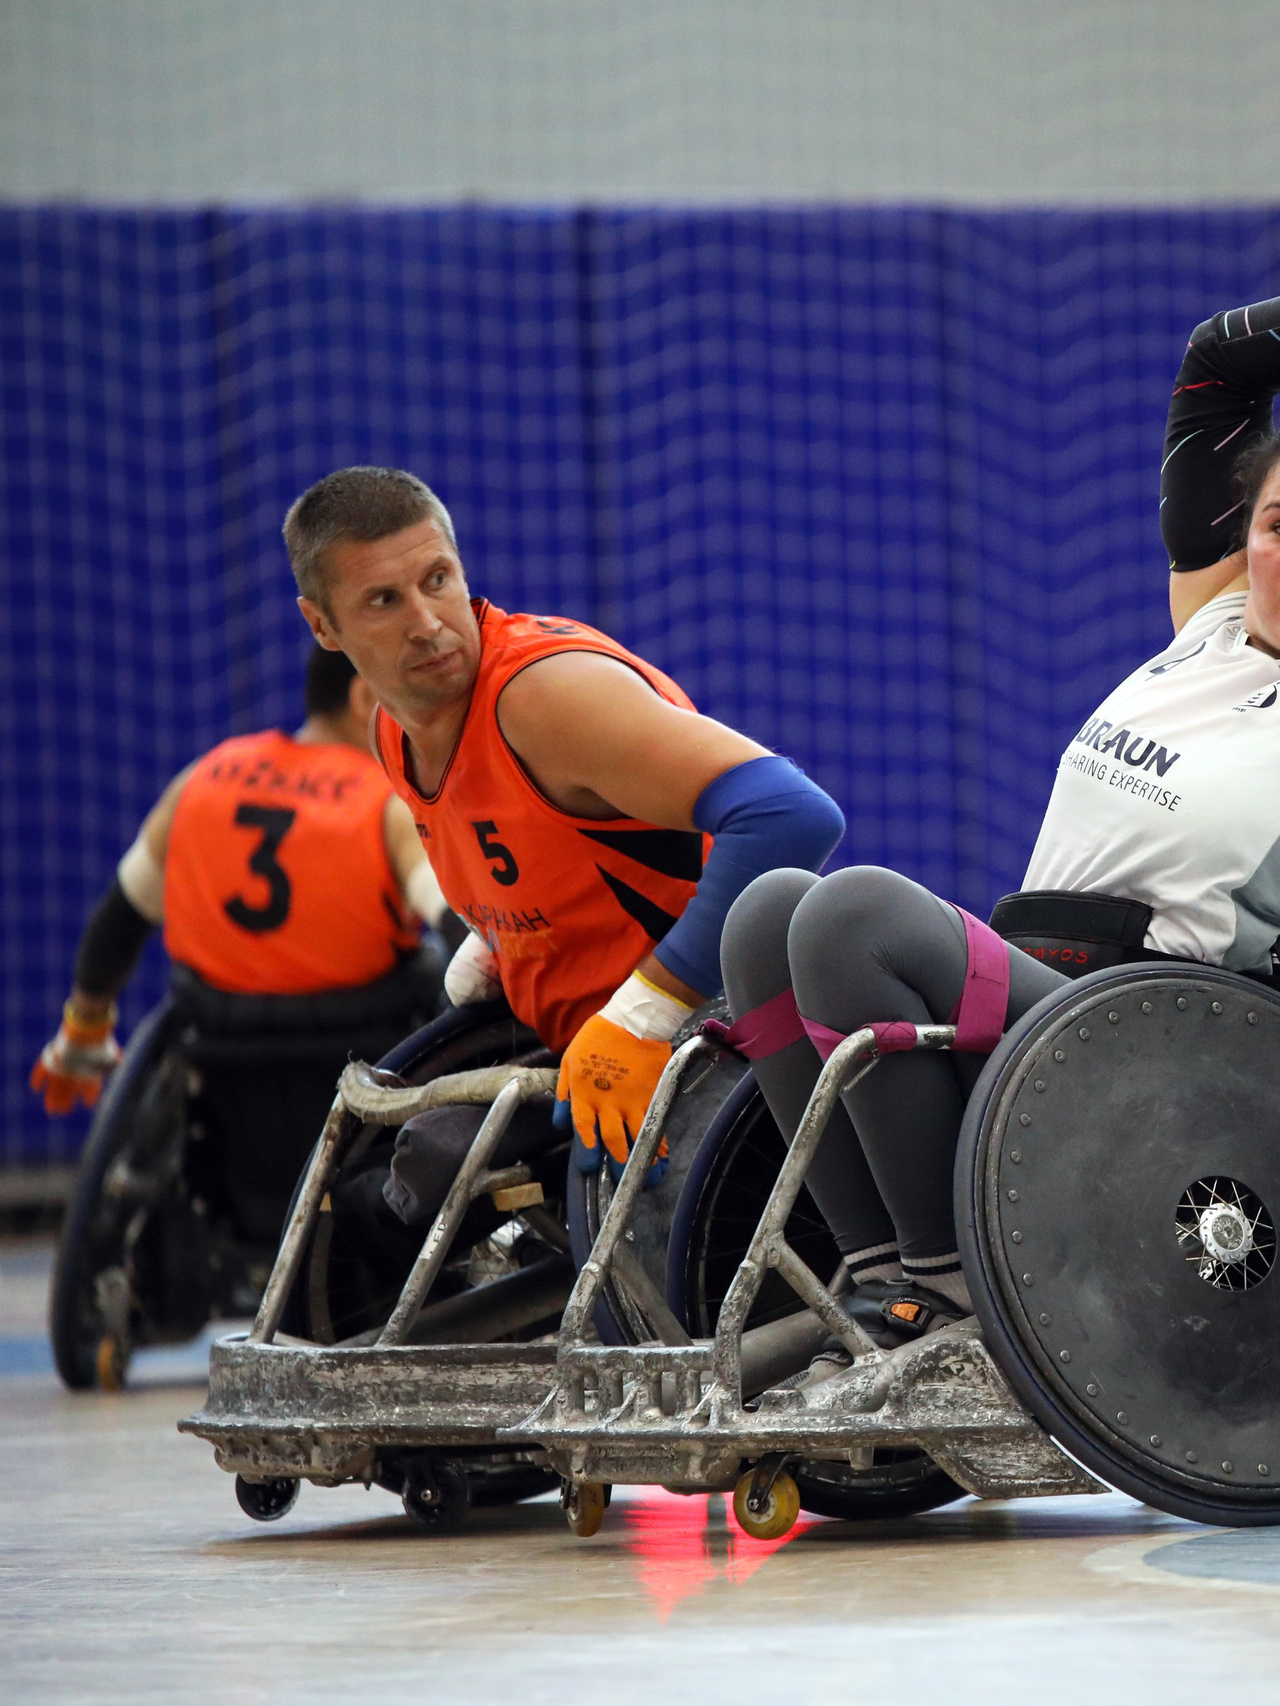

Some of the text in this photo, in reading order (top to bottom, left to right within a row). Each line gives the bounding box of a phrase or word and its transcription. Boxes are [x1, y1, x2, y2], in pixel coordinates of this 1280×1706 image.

[1075, 717, 1181, 778] BRAUN
[1109, 769, 1182, 812] EXPERTISE
[224, 802, 296, 935] 3
[471, 820, 519, 886] 5
